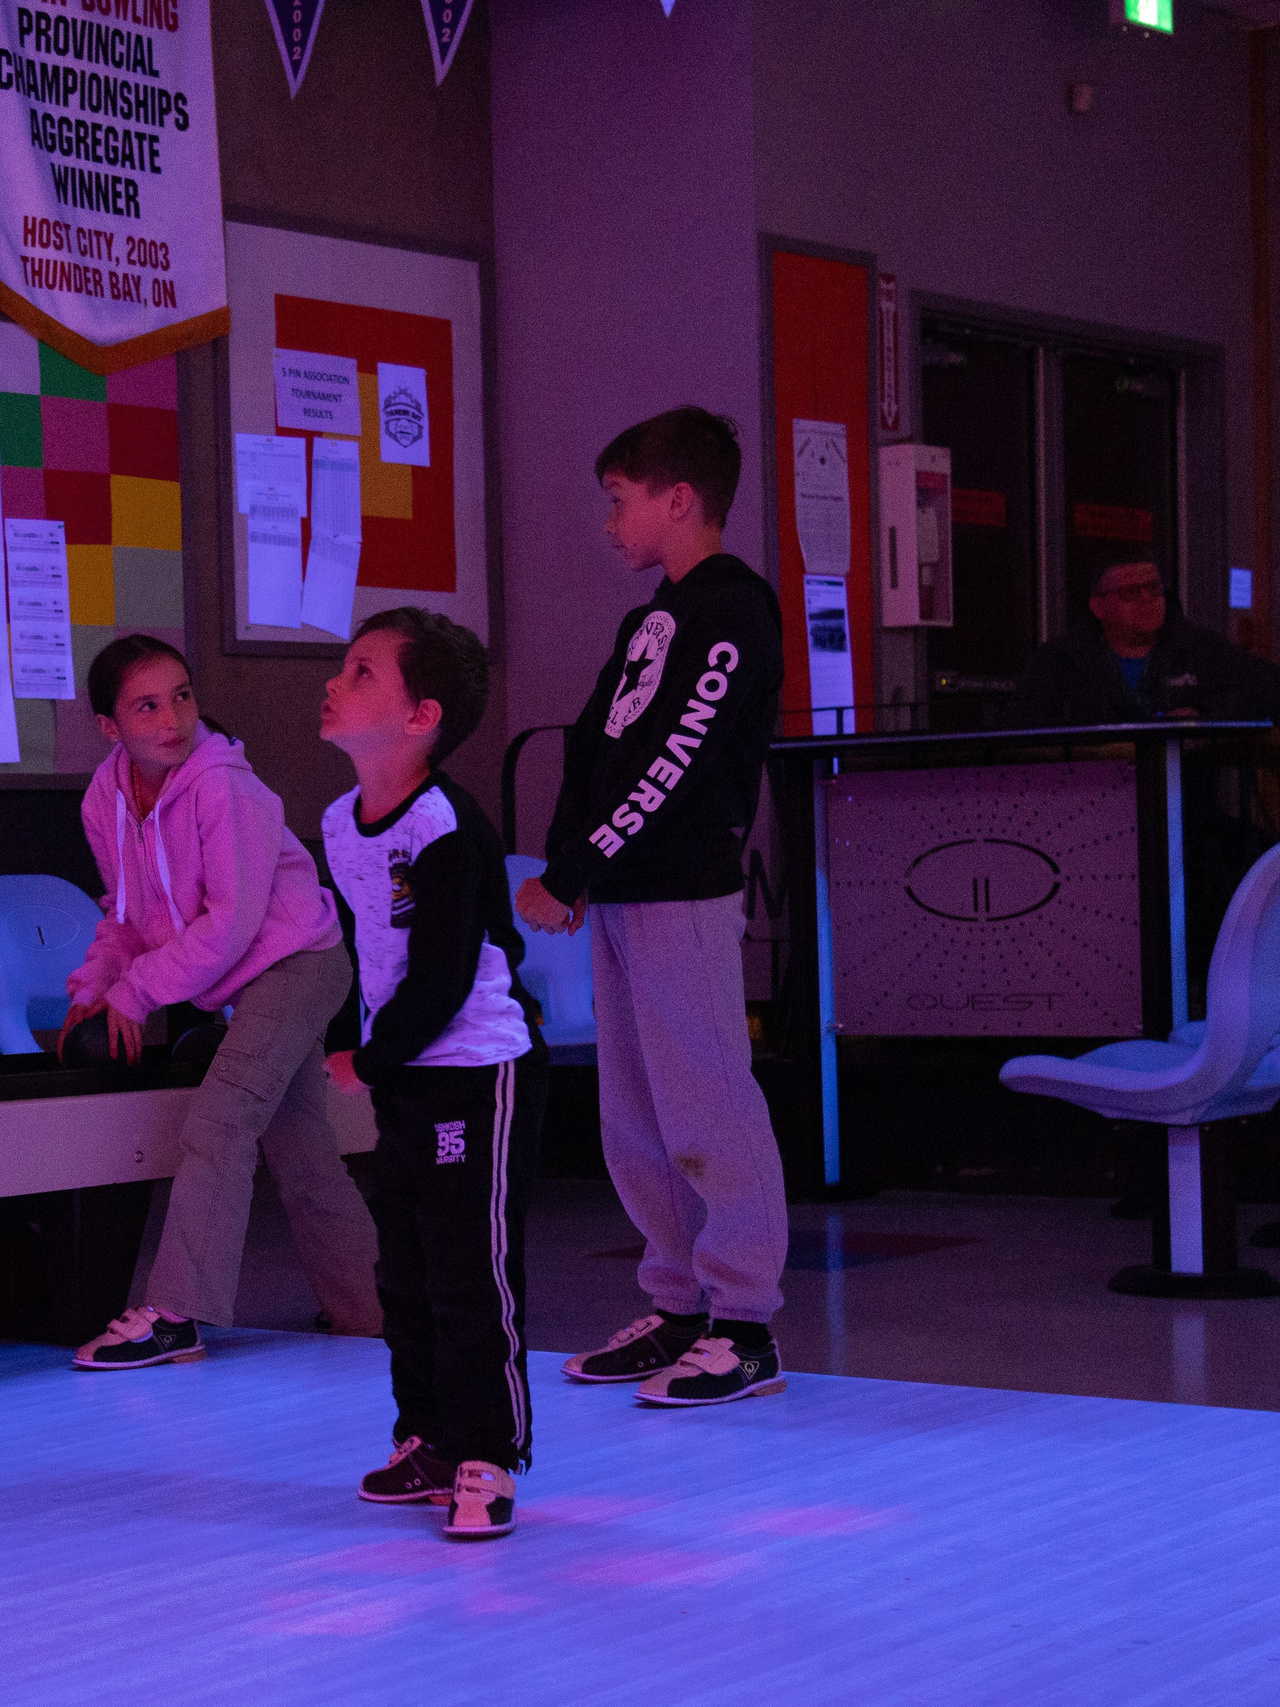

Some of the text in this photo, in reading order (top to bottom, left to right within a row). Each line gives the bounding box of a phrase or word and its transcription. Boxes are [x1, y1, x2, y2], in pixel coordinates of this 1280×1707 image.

[17, 6, 160, 78] PROVINCIAL
[81, 0, 179, 32] WLING
[441, 0, 453, 43] 02
[30, 107, 162, 175] AGGREGATE
[50, 162, 141, 219] WINNER
[23, 215, 170, 271] HOST CITY, 2003
[20, 255, 177, 309] THUNDER BAY, ON
[588, 641, 739, 859] CONVERSE
[906, 993, 1065, 1011] QUEST
[436, 1130, 466, 1157] 95
